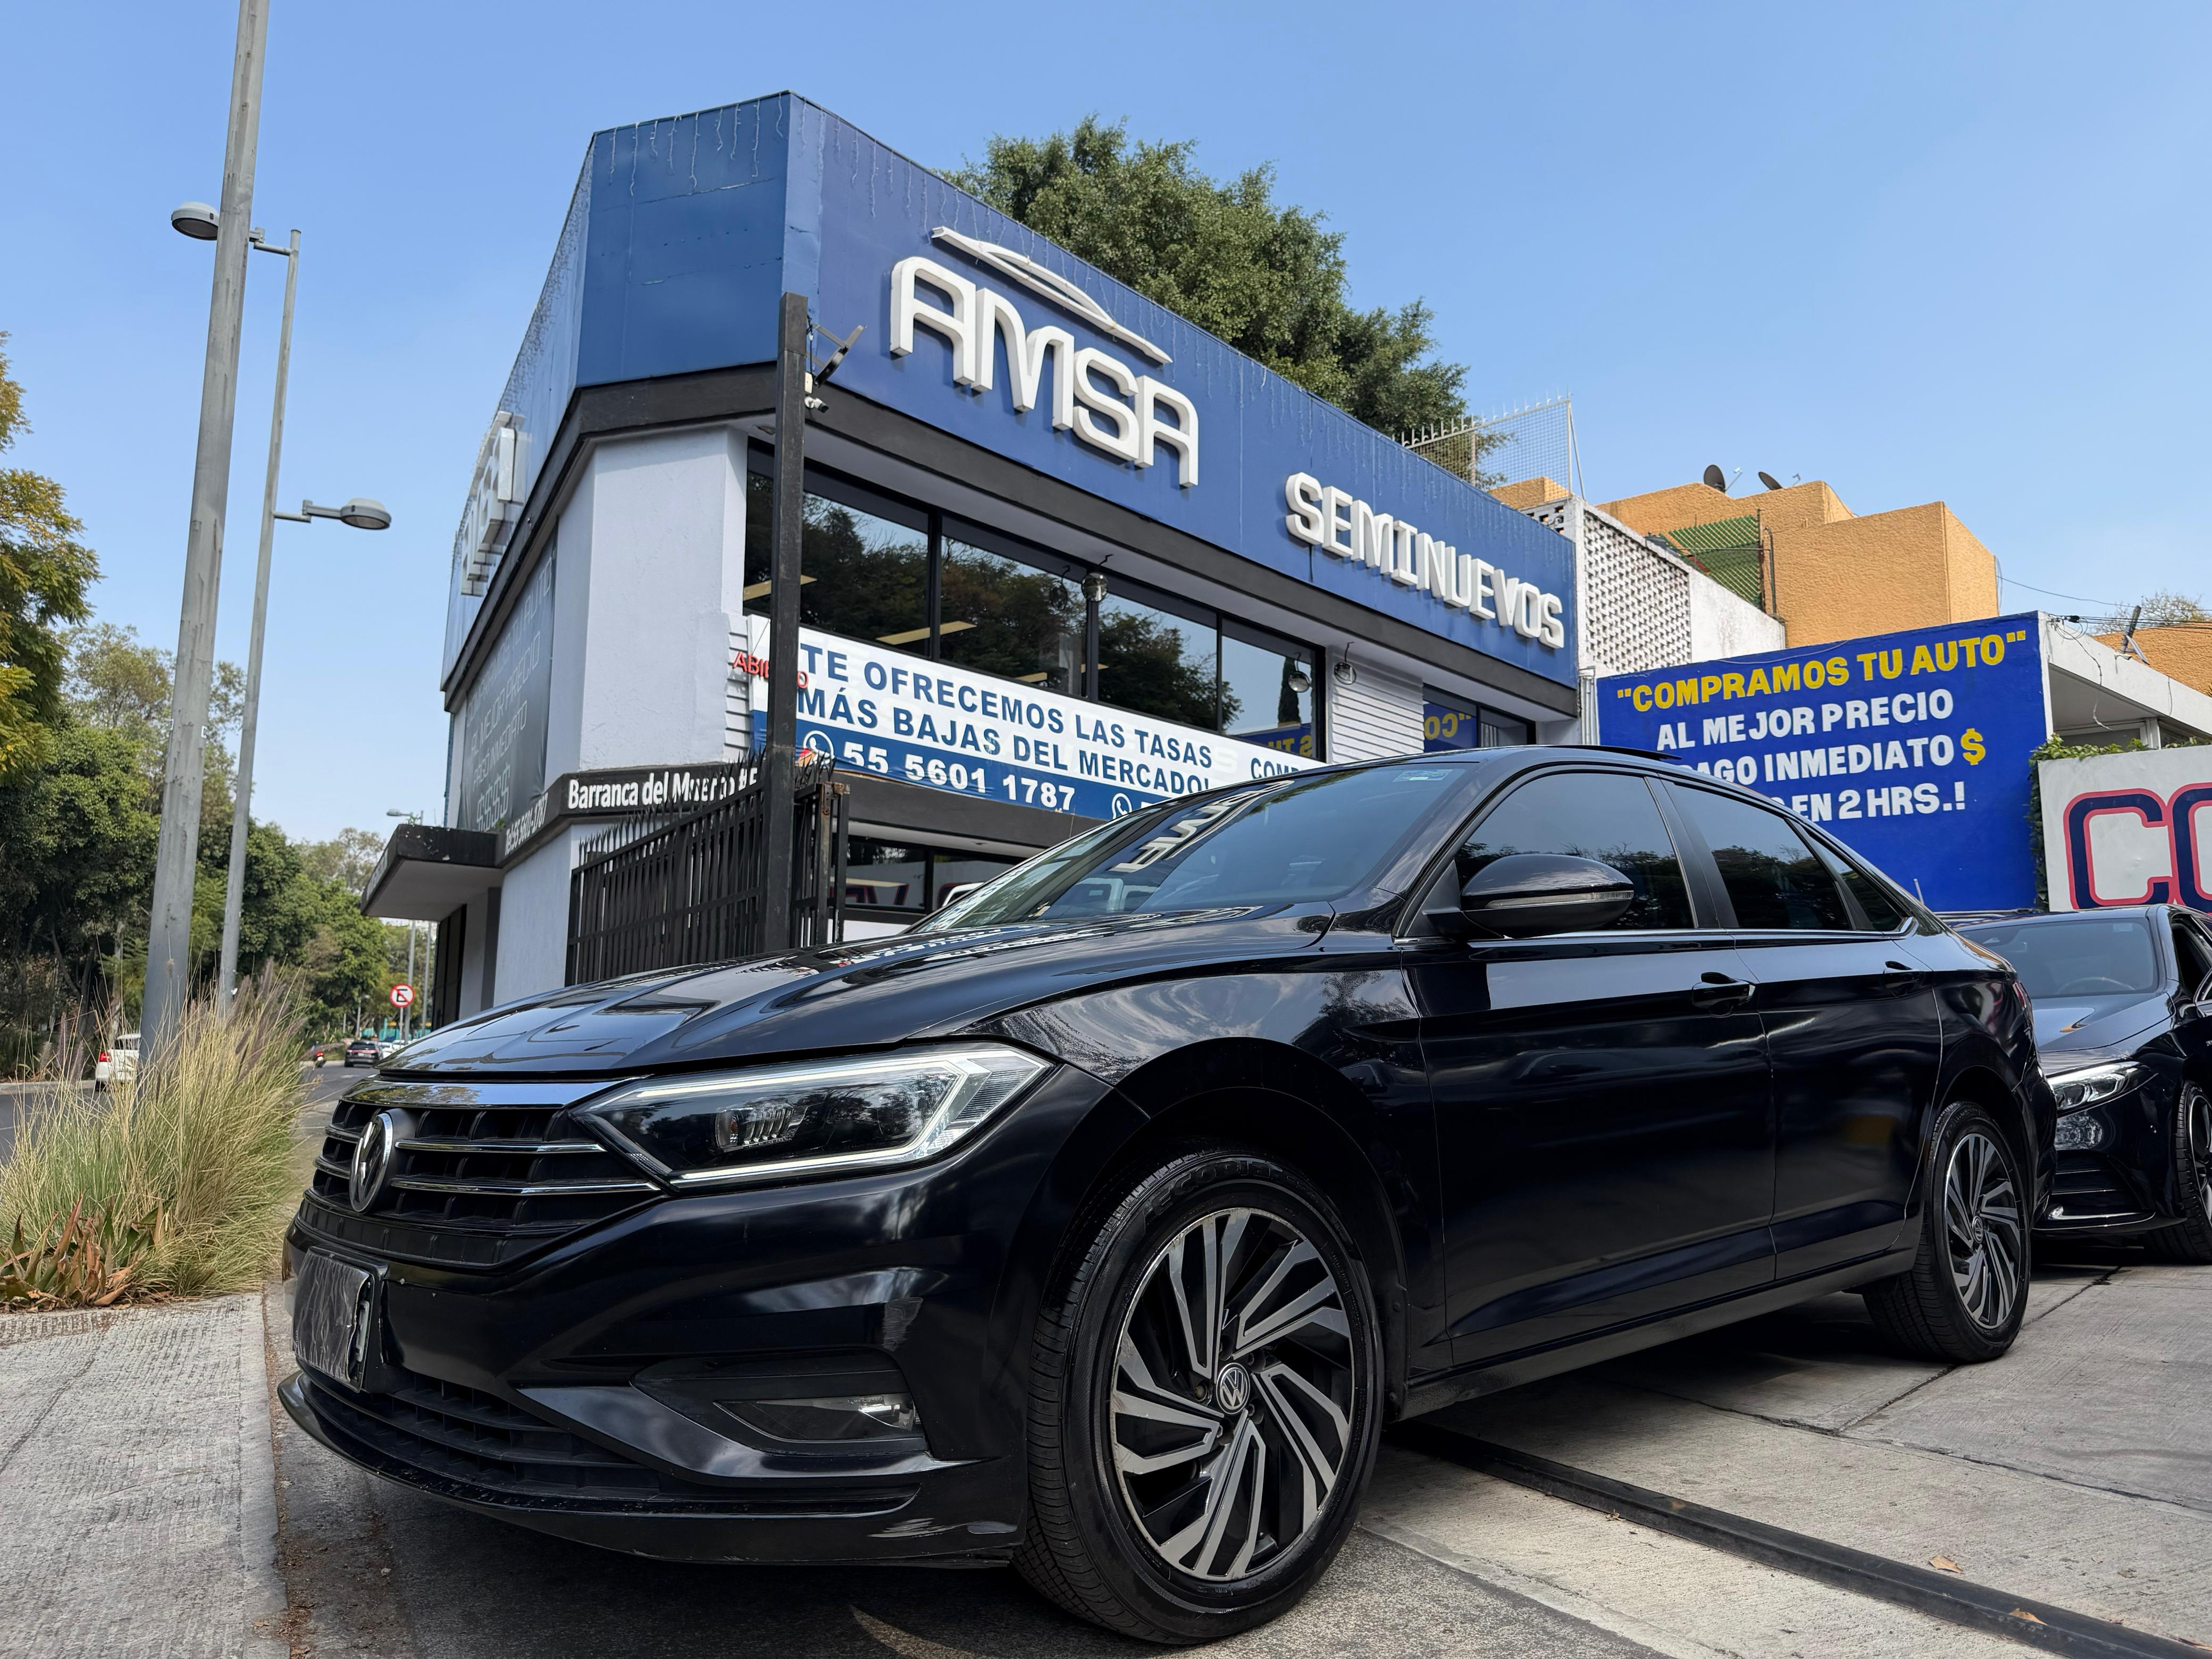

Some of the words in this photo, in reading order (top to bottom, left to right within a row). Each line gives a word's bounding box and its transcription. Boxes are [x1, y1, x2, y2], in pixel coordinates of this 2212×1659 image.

[890, 256, 1199, 487] AMSA
[1285, 472, 1564, 649] SEMINUEVOS
[1857, 648, 1903, 681] TU
[798, 686, 878, 729] MÁS
[893, 707, 1001, 756] BAJAS
[1013, 734, 1068, 771] DEL
[800, 643, 849, 683] TE
[864, 661, 1064, 734] OFRECEMOS
[1075, 714, 1125, 748] LAS
[1134, 729, 1212, 768] TASAS
[1656, 722, 1695, 751] AL
[1703, 706, 1815, 746] MEJOR
[1821, 689, 1954, 733] PRECIO
[568, 778, 639, 809] Barranca
[642, 772, 669, 805] del
[843, 740, 889, 774] 55
[905, 753, 987, 793] 5601
[1002, 774, 1076, 811] 1787
[1764, 734, 1955, 783] INMEDIATO
[1838, 789, 1862, 820] 2
